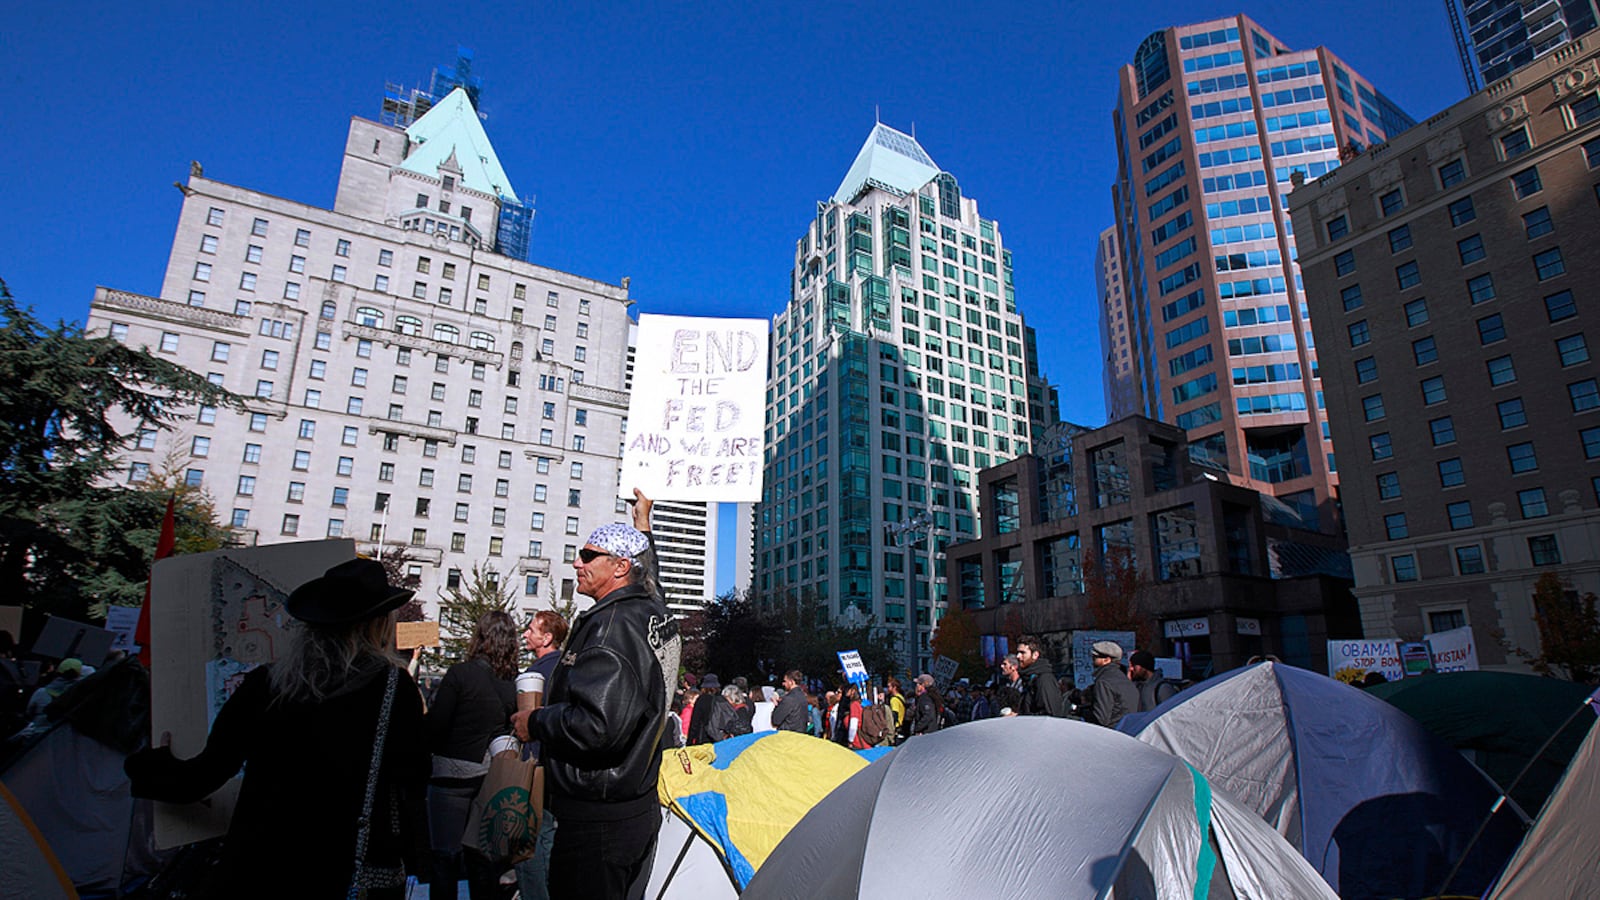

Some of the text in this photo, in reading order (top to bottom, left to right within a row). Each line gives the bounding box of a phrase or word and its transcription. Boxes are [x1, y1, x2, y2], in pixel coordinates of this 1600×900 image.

[671, 328, 760, 375] END
[677, 377, 725, 395] THE
[662, 398, 741, 433] FED
[628, 432, 672, 456] AND
[716, 437, 761, 457] ARE
[1341, 643, 1391, 657] OBAMA
[1353, 657, 1376, 668] STOP
